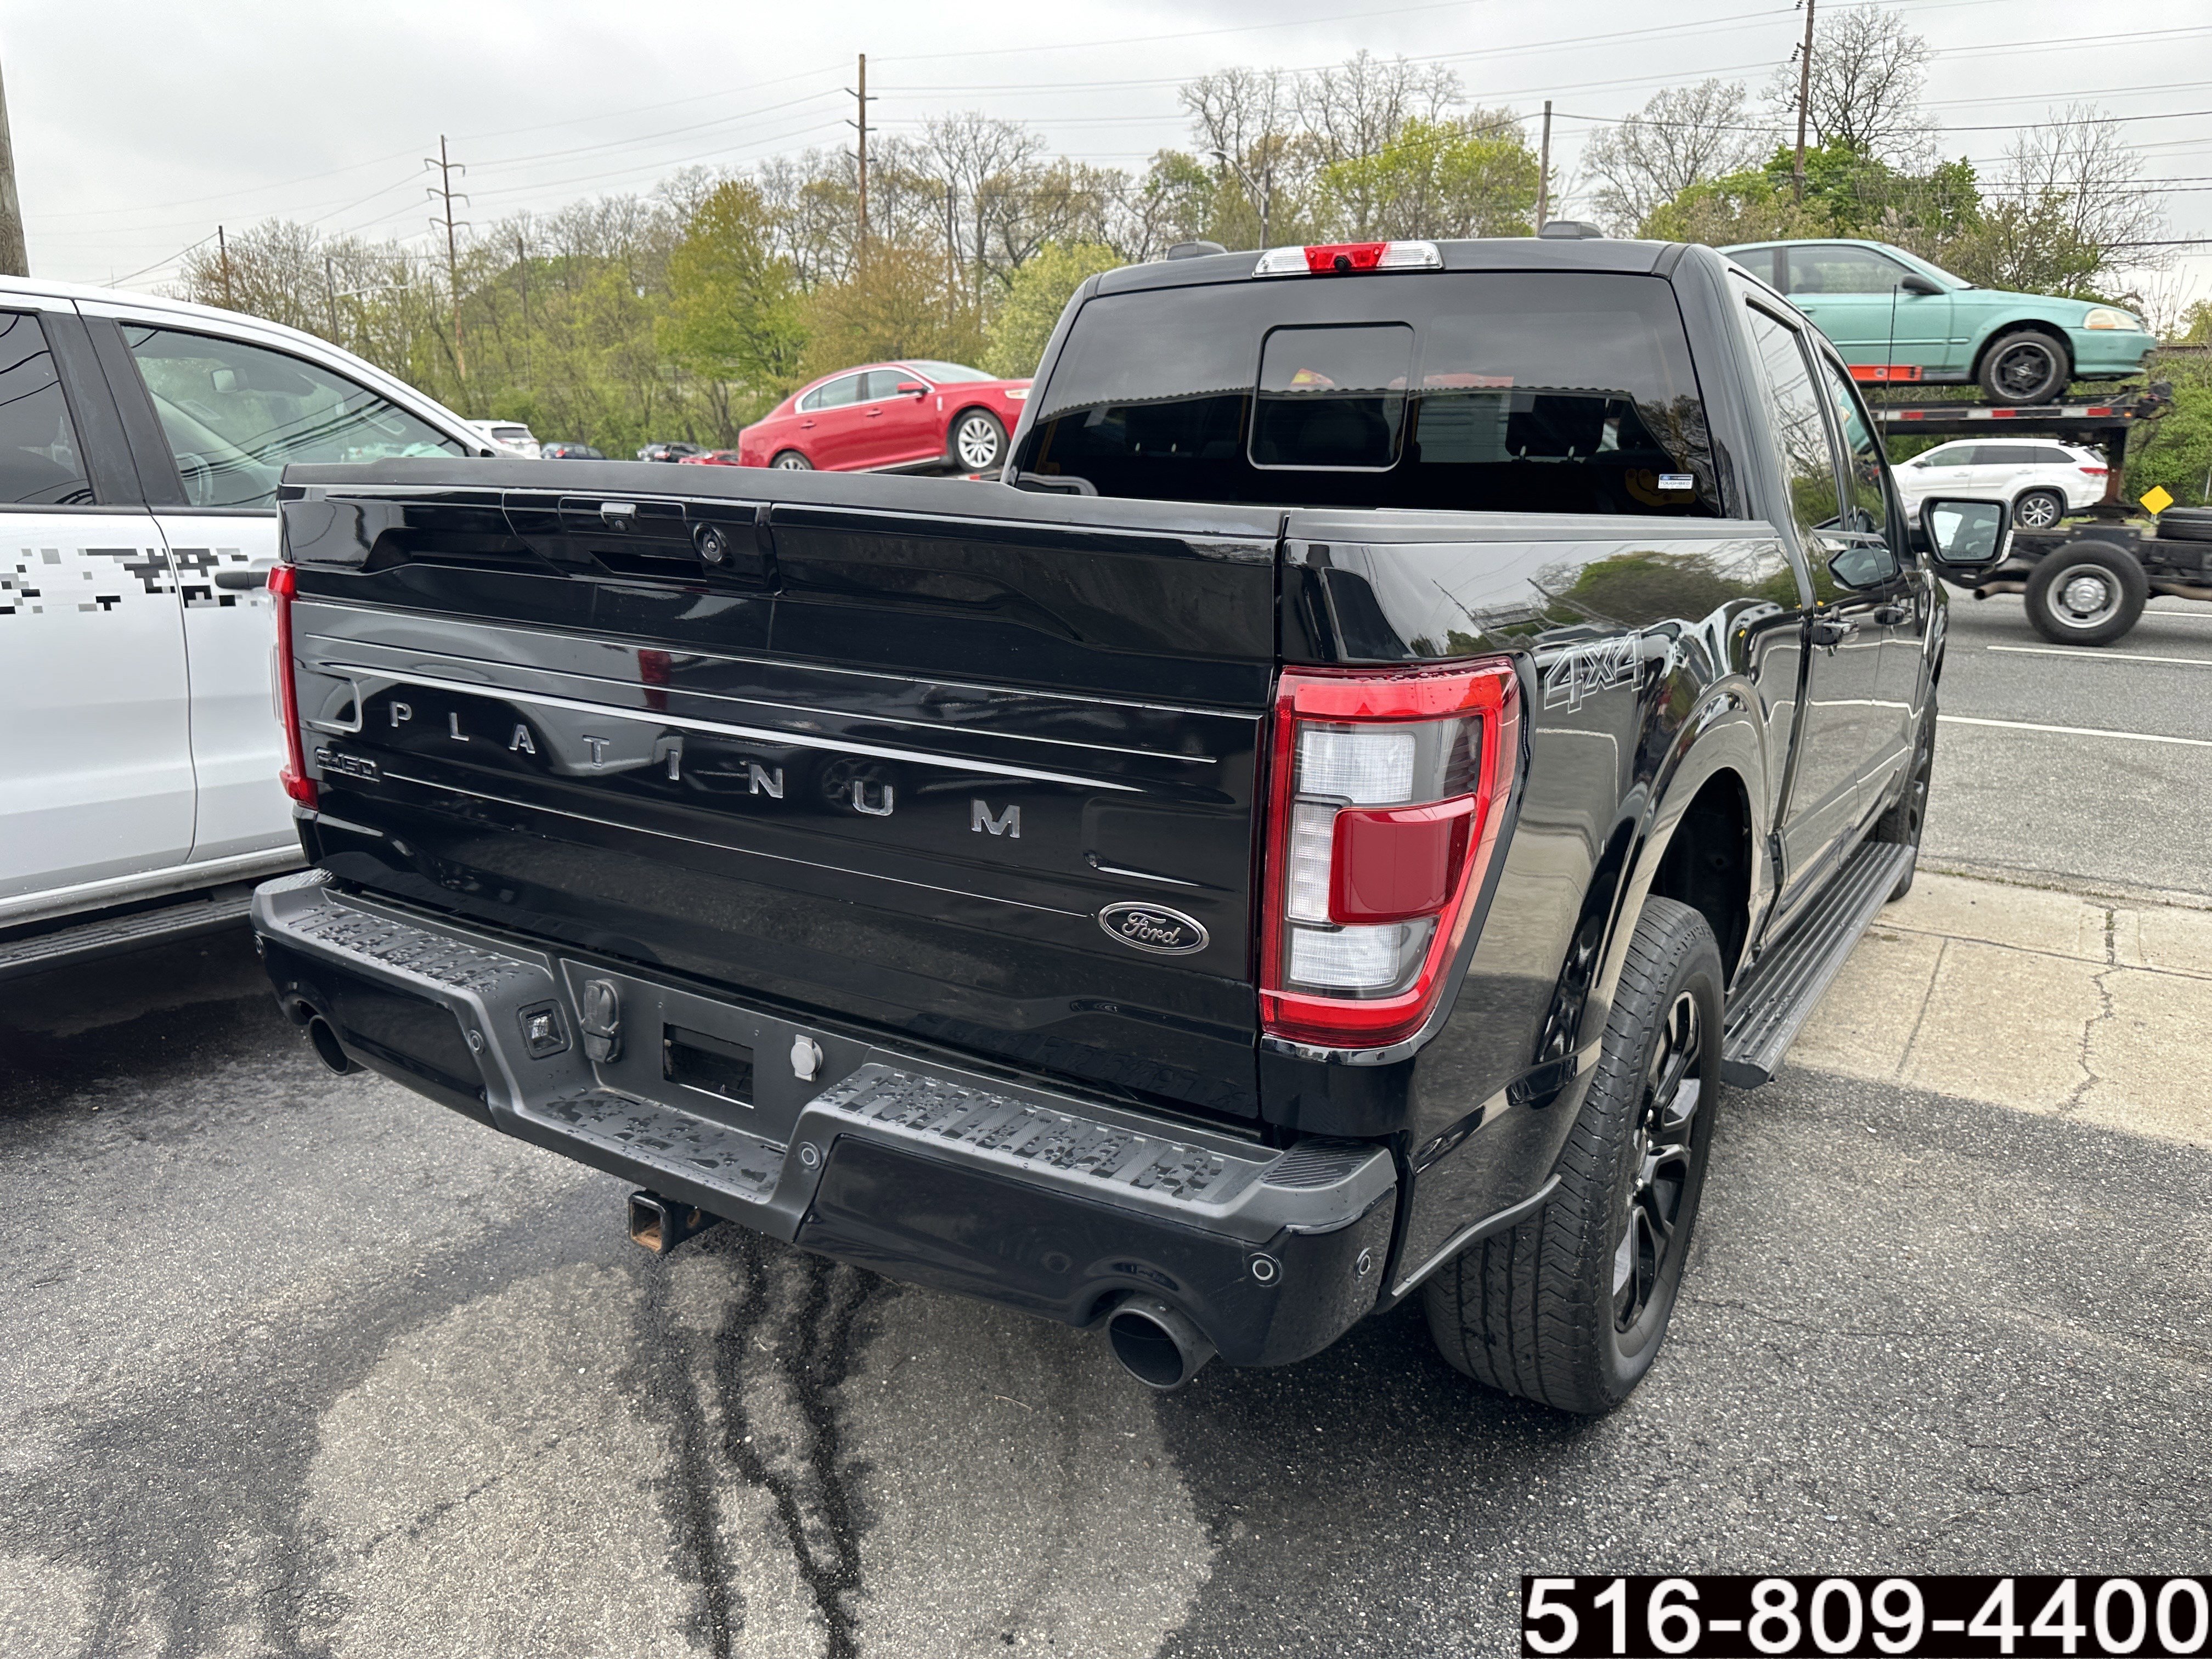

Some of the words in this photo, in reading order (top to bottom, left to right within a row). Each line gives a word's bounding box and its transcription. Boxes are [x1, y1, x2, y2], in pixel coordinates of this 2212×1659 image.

[315, 747, 377, 778] F-150
[390, 701, 1022, 838] PLATINUM
[1121, 912, 1181, 945] Ford
